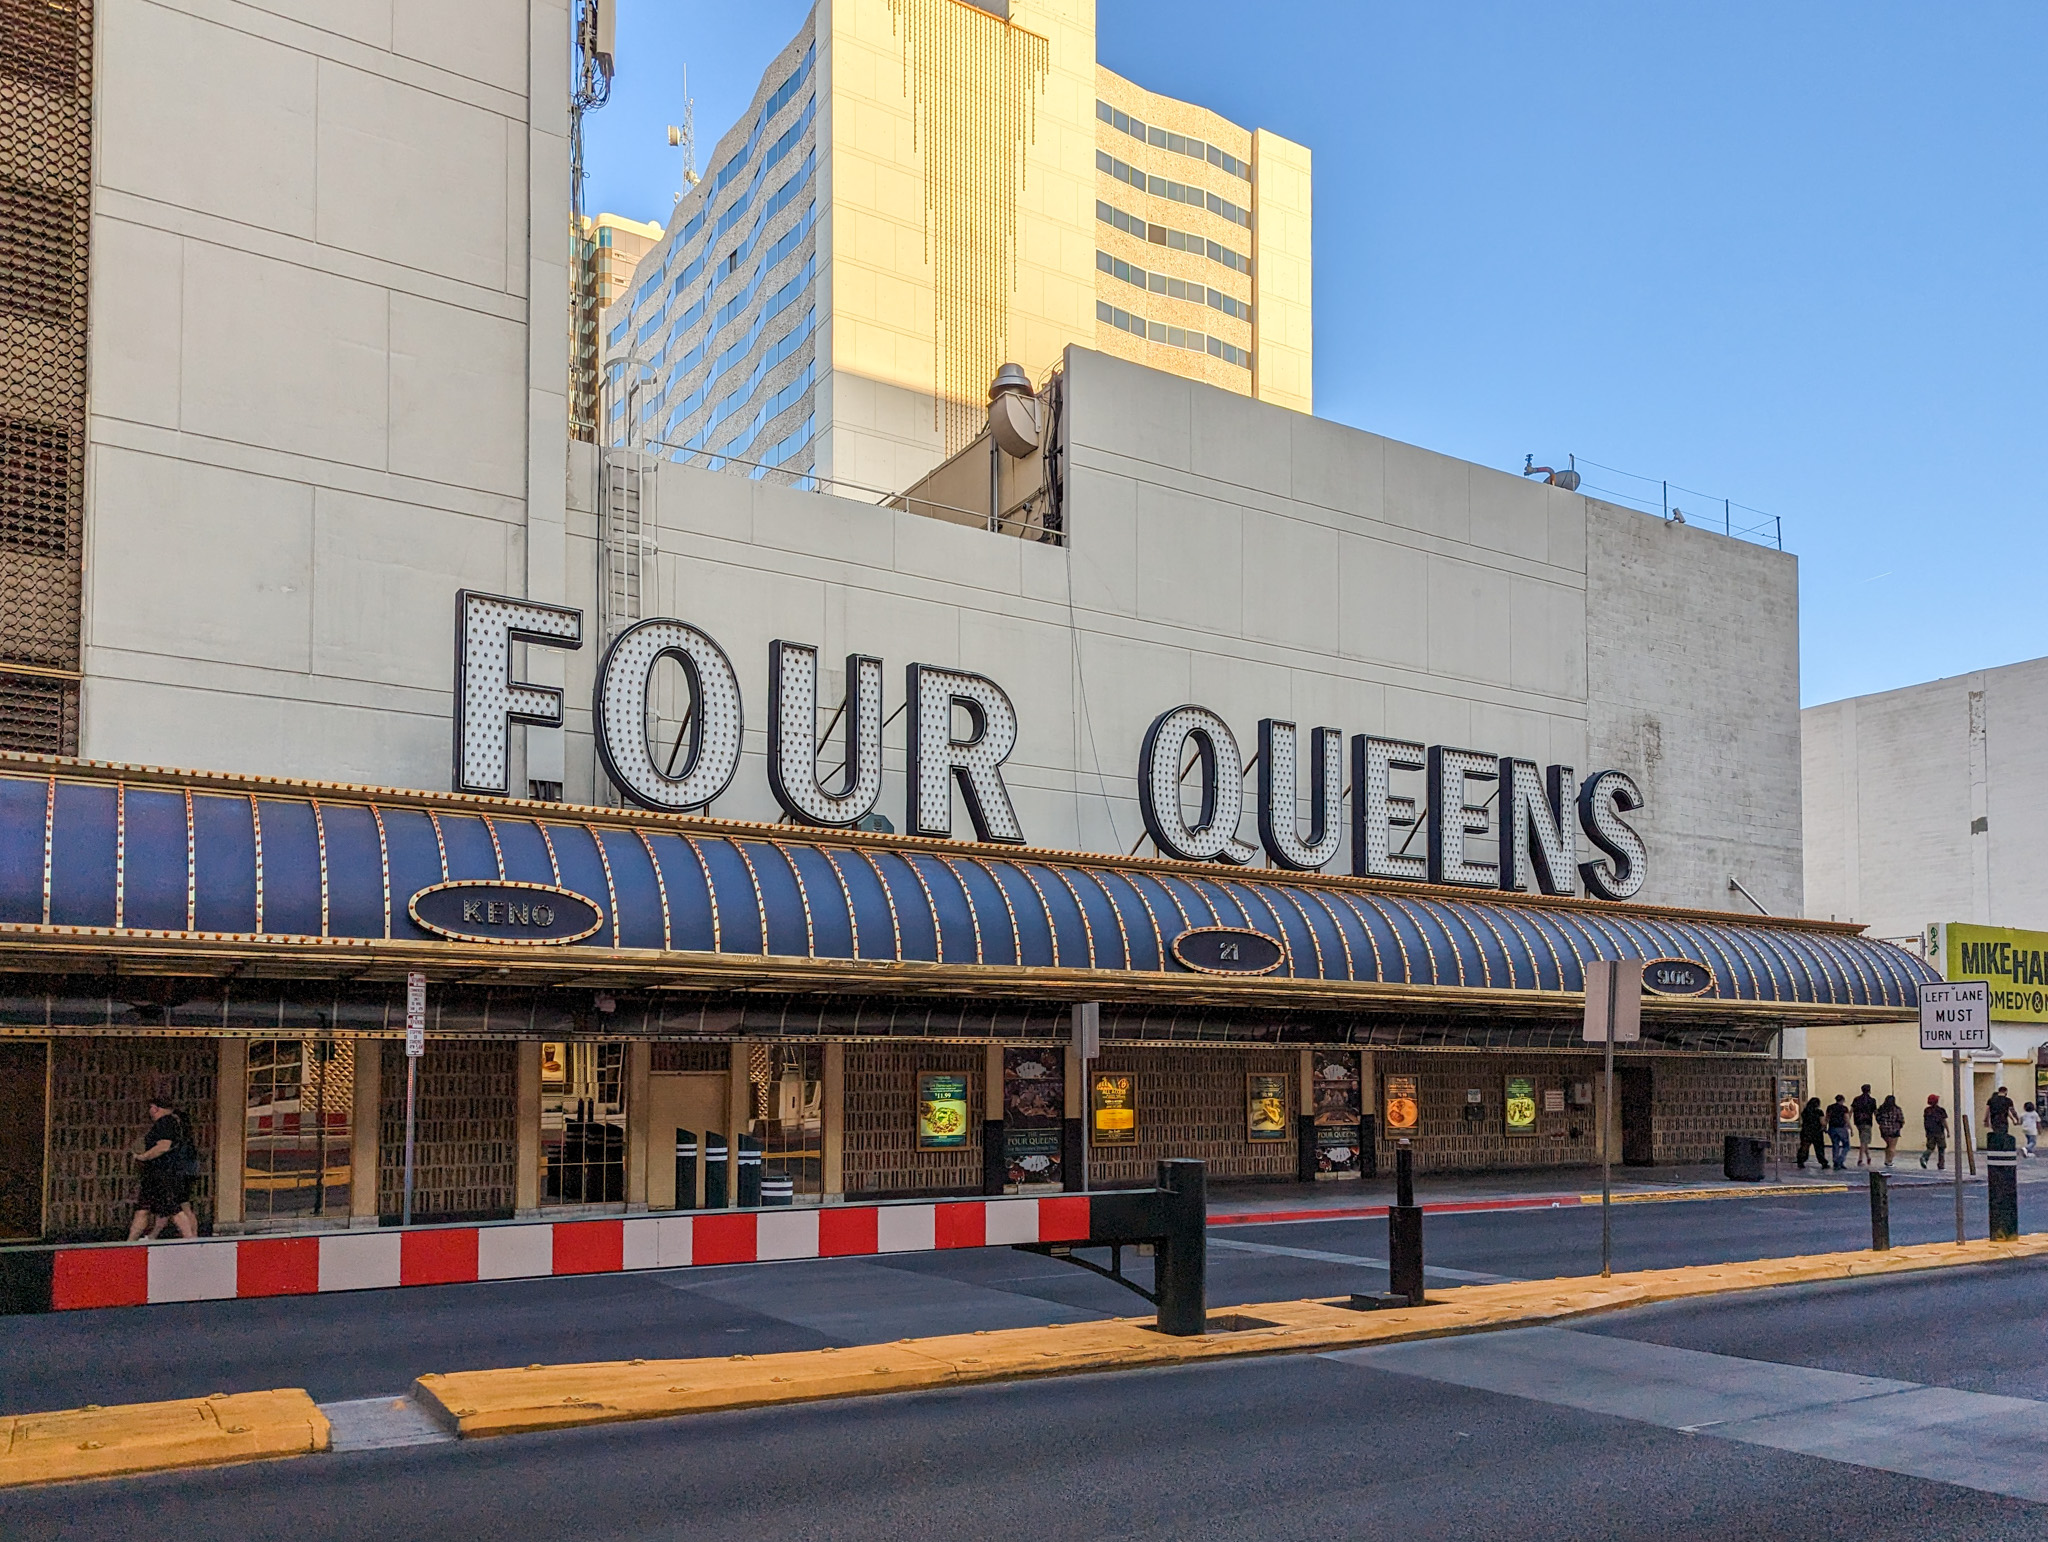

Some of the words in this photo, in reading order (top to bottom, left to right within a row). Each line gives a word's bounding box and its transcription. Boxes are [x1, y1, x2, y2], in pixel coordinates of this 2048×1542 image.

[452, 588, 1027, 845] FOUR
[1138, 704, 1648, 901] QUEENS
[463, 899, 554, 927] KENO
[1220, 942, 1239, 960] 21
[1656, 969, 1695, 986] SLOTS
[1925, 991, 1949, 1003] LEFT
[1955, 990, 1984, 1002] LANE
[1936, 1008, 1973, 1022] MUST
[1925, 1030, 1952, 1041] TURN
[1960, 1029, 1985, 1040] LEFT
[1007, 1137, 1028, 1146] FOUR
